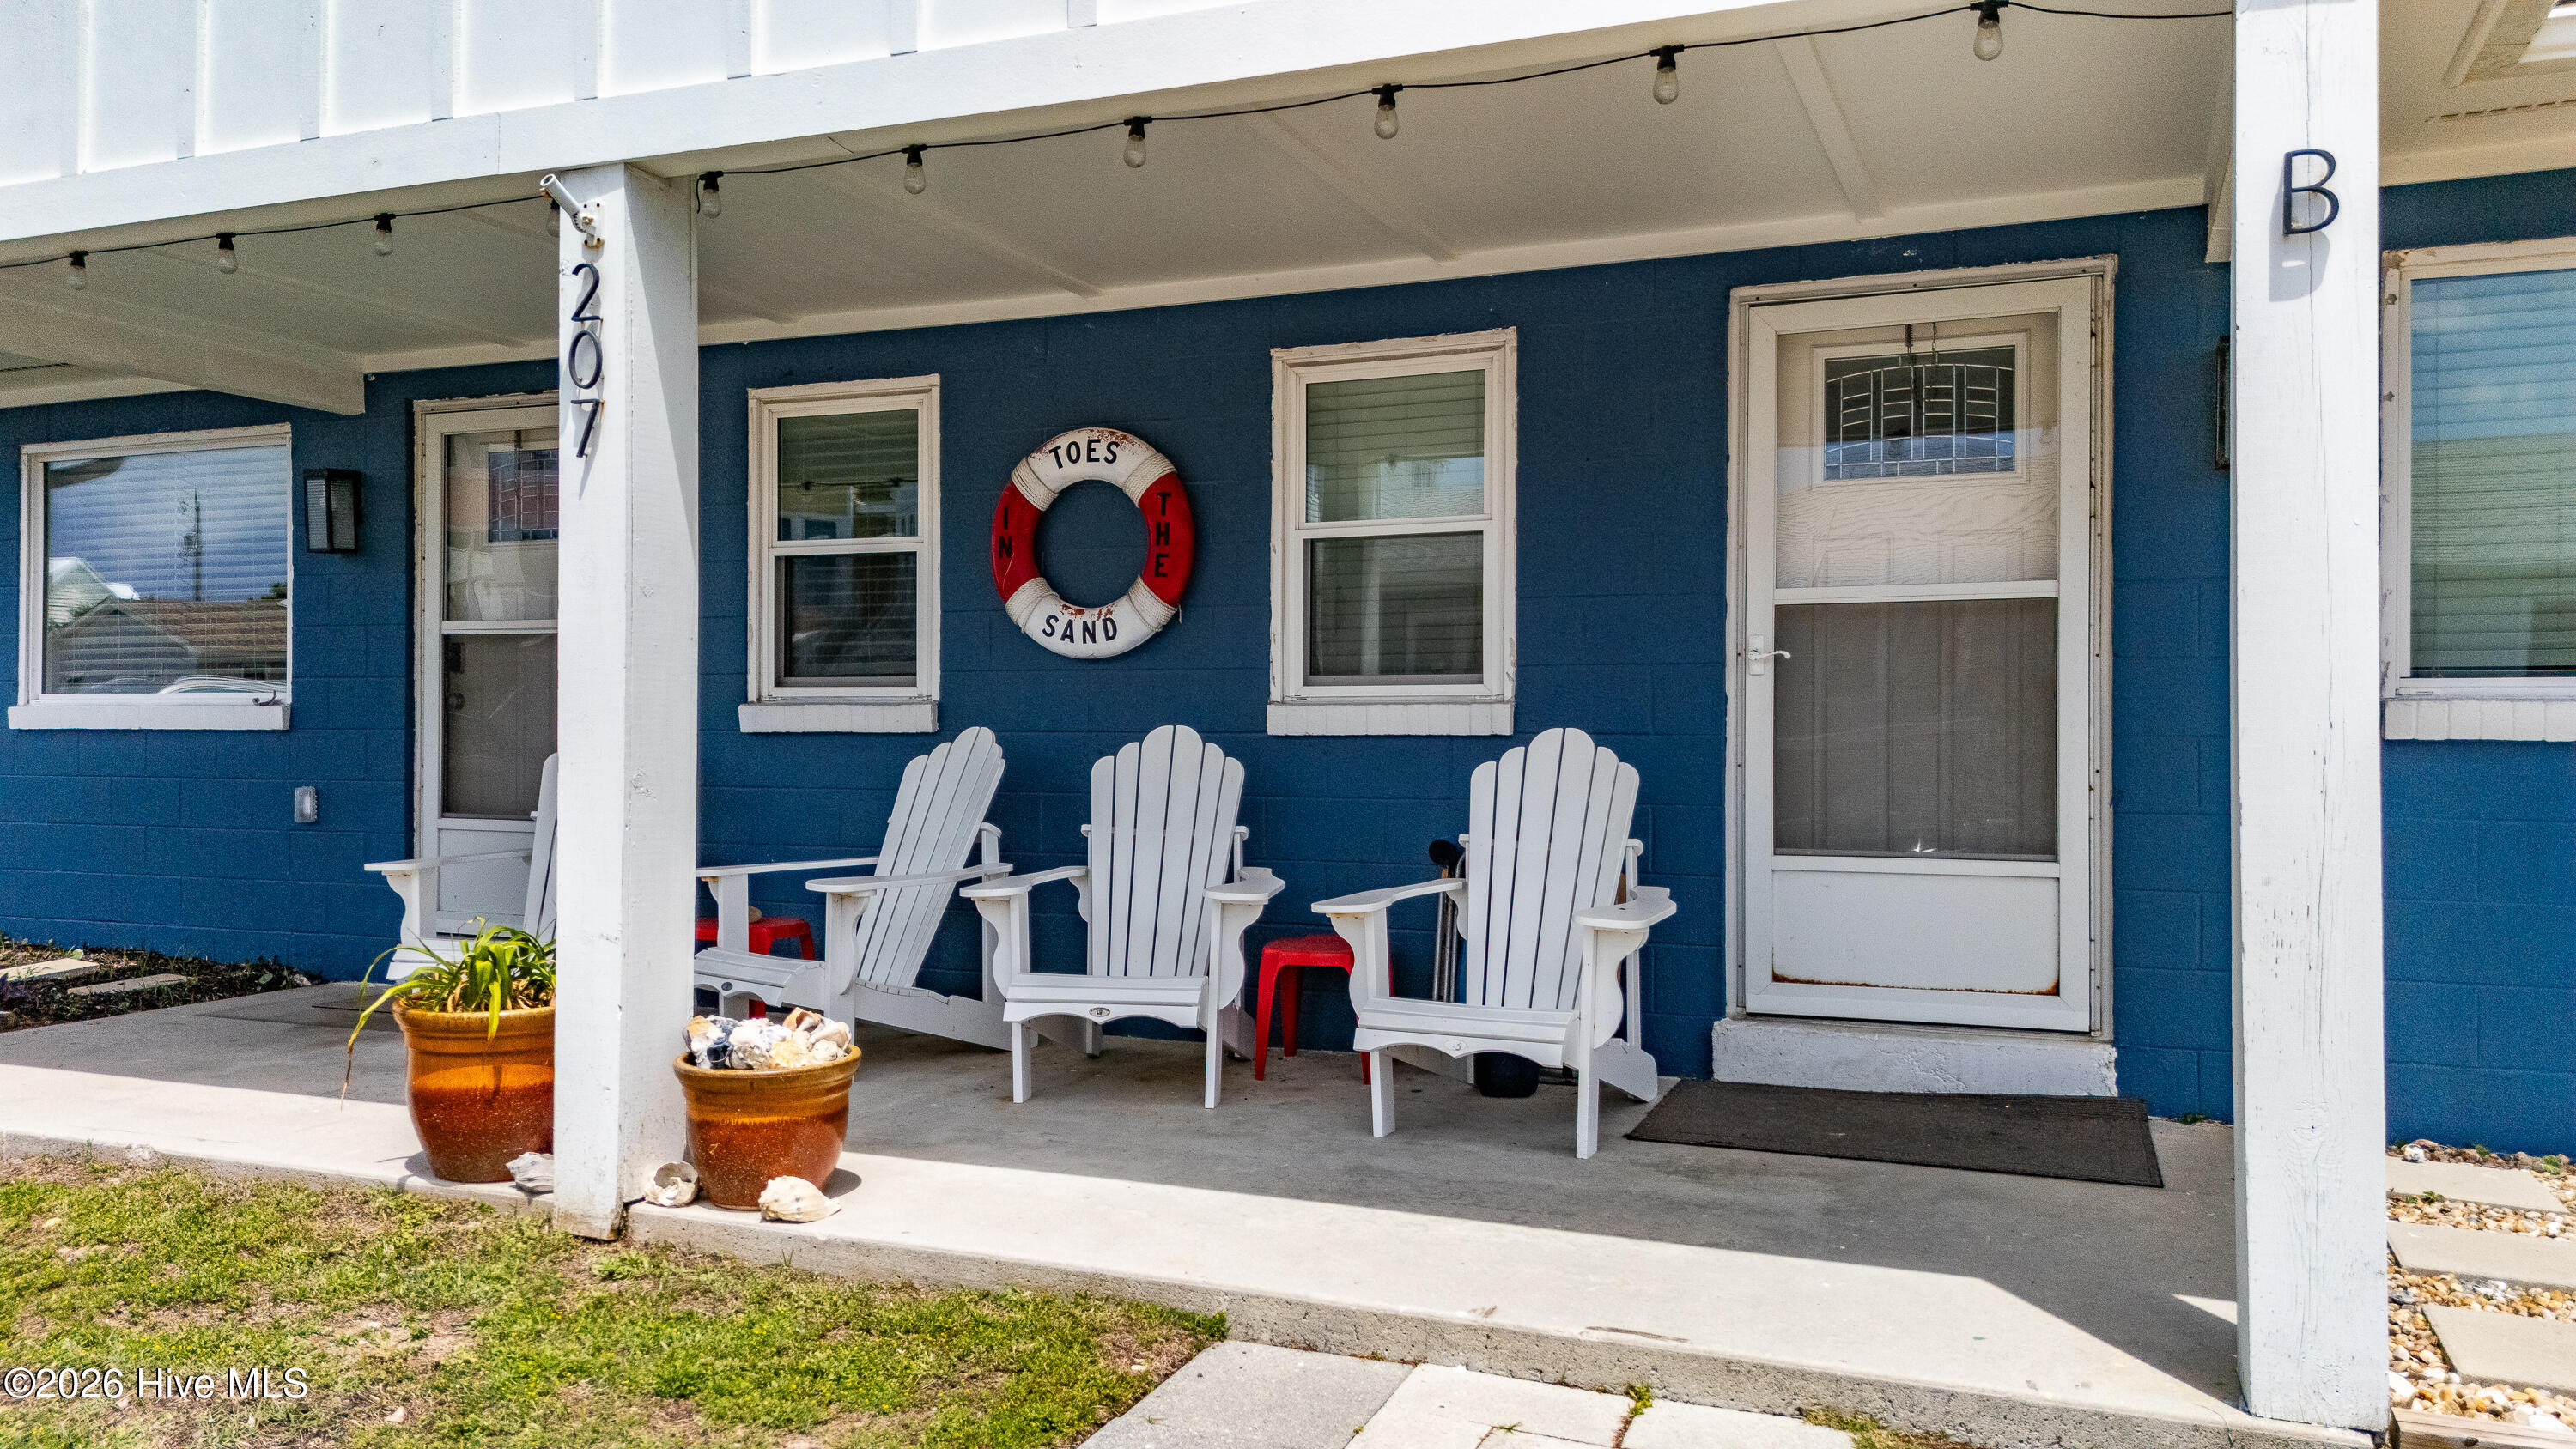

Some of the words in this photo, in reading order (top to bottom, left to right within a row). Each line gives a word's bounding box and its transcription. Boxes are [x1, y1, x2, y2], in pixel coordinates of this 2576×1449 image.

[2283, 149, 2339, 235] B
[568, 263, 603, 458] 207
[1048, 439, 1120, 469] TOES
[999, 506, 1012, 559] IN
[1154, 492, 1171, 578] THE
[1042, 615, 1117, 644] SAND
